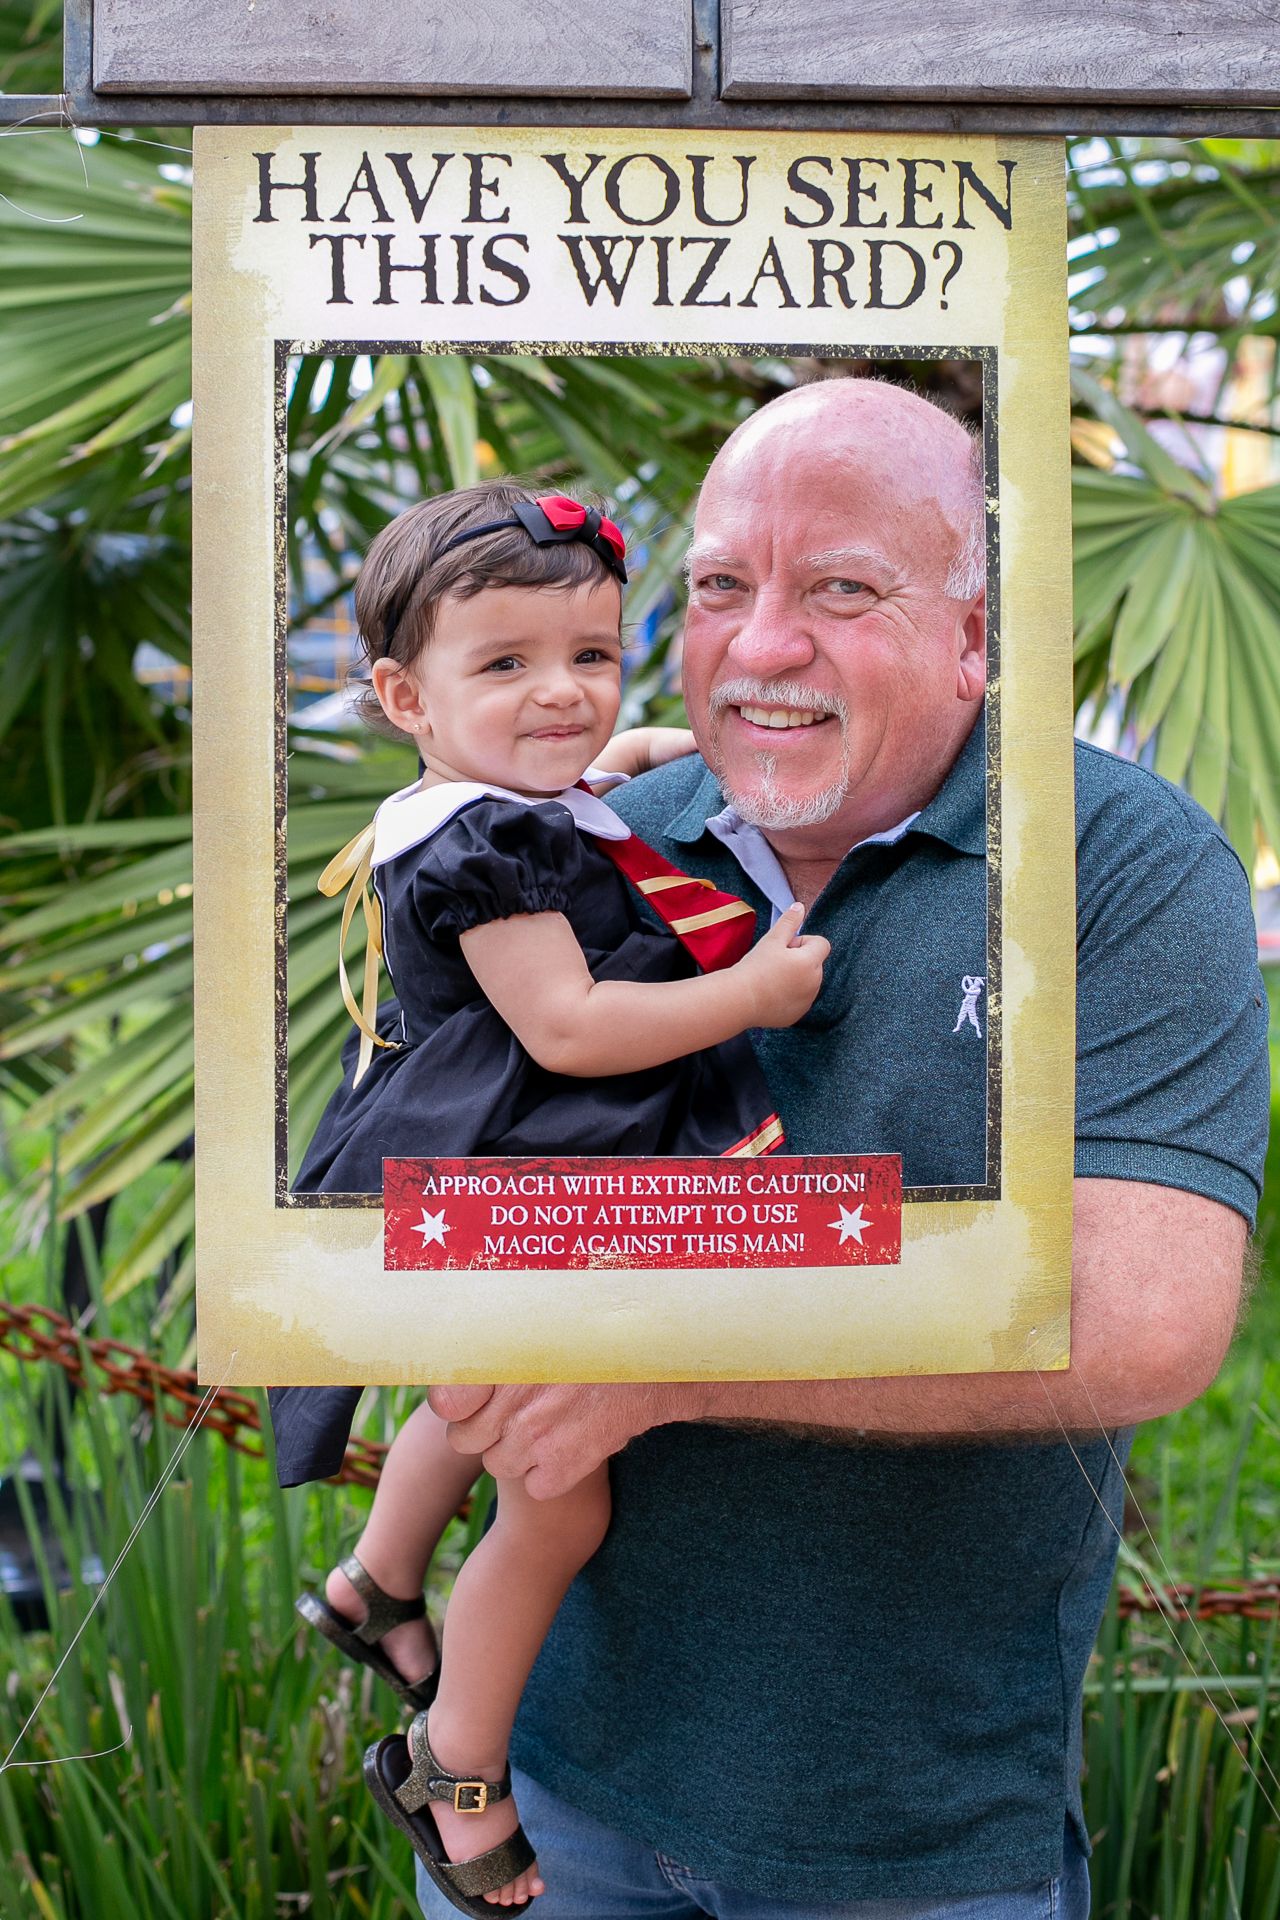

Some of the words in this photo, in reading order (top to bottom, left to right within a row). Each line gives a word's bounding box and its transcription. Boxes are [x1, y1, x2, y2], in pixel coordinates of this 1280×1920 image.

[252, 151, 513, 224] HAVE
[545, 152, 755, 227] YOU
[784, 155, 1018, 231] SEEN
[308, 233, 531, 307] THIS
[557, 234, 964, 311] WIZARD?
[421, 1174, 555, 1197] APPROACH
[561, 1174, 626, 1196] WITH
[630, 1174, 742, 1196] EXTREME
[746, 1173, 866, 1195] CAUTION!
[490, 1205, 527, 1226] DO
[532, 1205, 588, 1226] NOT
[592, 1205, 707, 1226] ATTEMPT
[711, 1204, 749, 1225] TO
[751, 1203, 799, 1224] USE
[483, 1235, 566, 1256] MAGIC
[570, 1233, 677, 1256] AGAINST
[683, 1233, 738, 1255] THIS
[742, 1233, 806, 1254] MAN!
